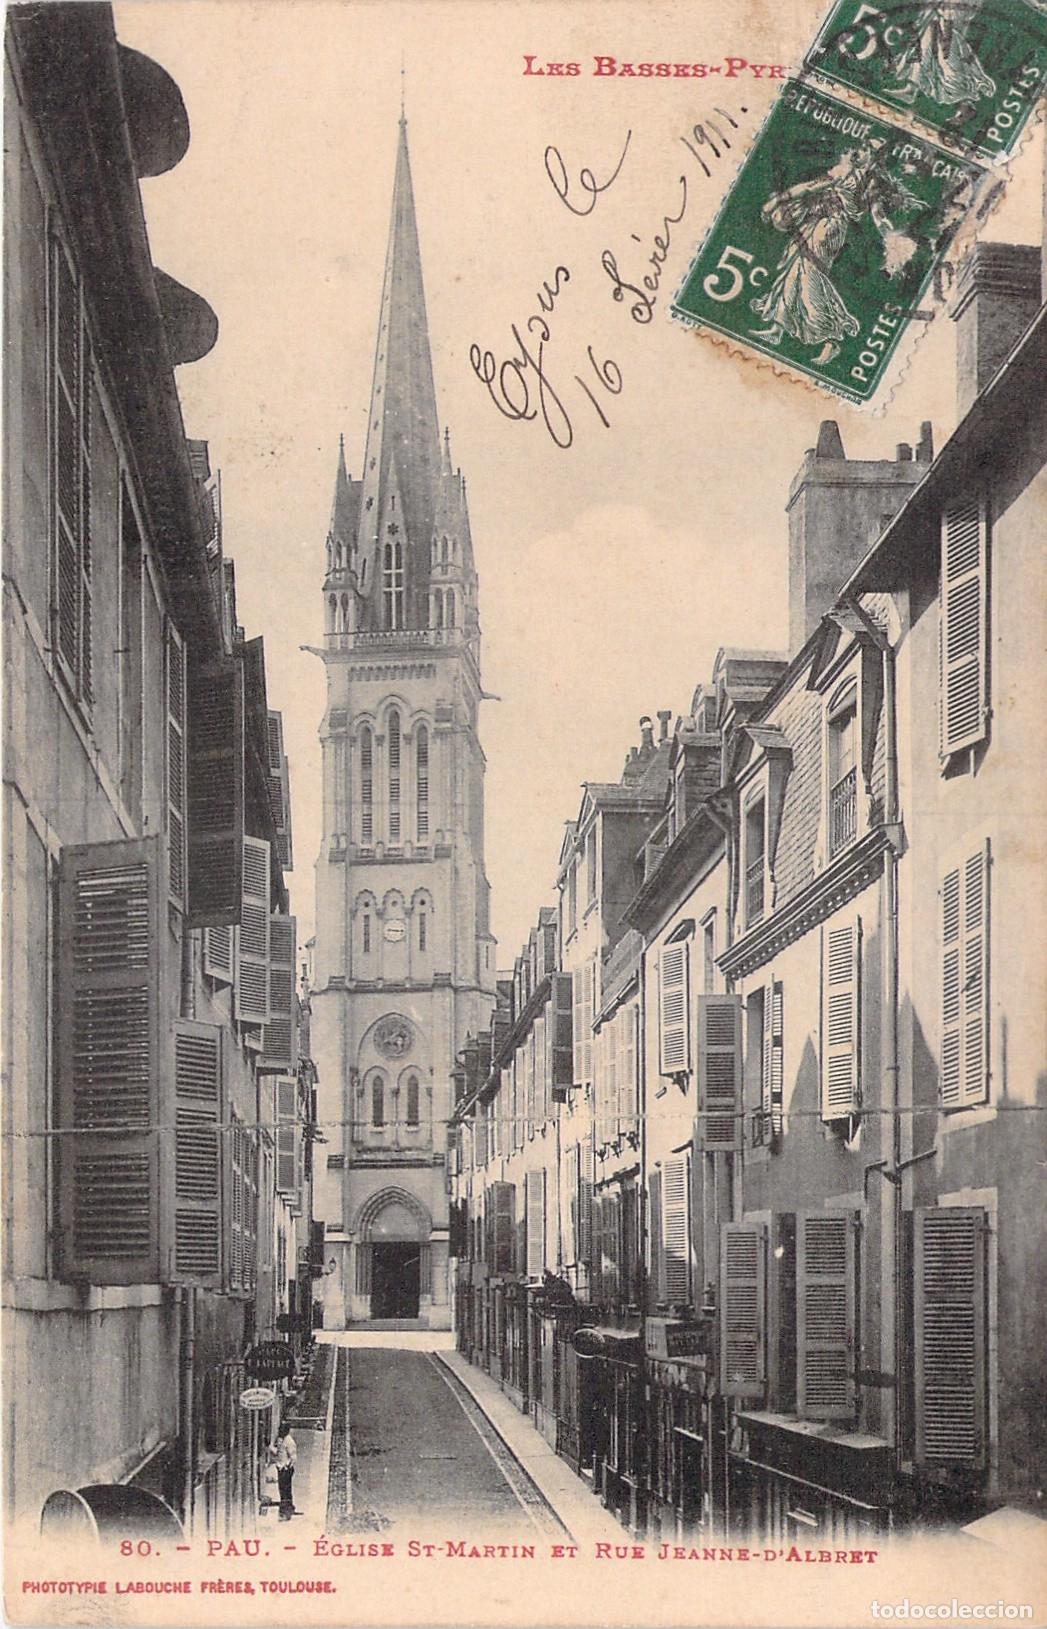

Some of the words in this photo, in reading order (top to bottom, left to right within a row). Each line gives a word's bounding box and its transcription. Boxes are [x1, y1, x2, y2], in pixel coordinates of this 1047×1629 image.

[986, 64, 1040, 143] POSTES
[850, 302, 902, 382] POSTES
[574, 344, 623, 430] 16
